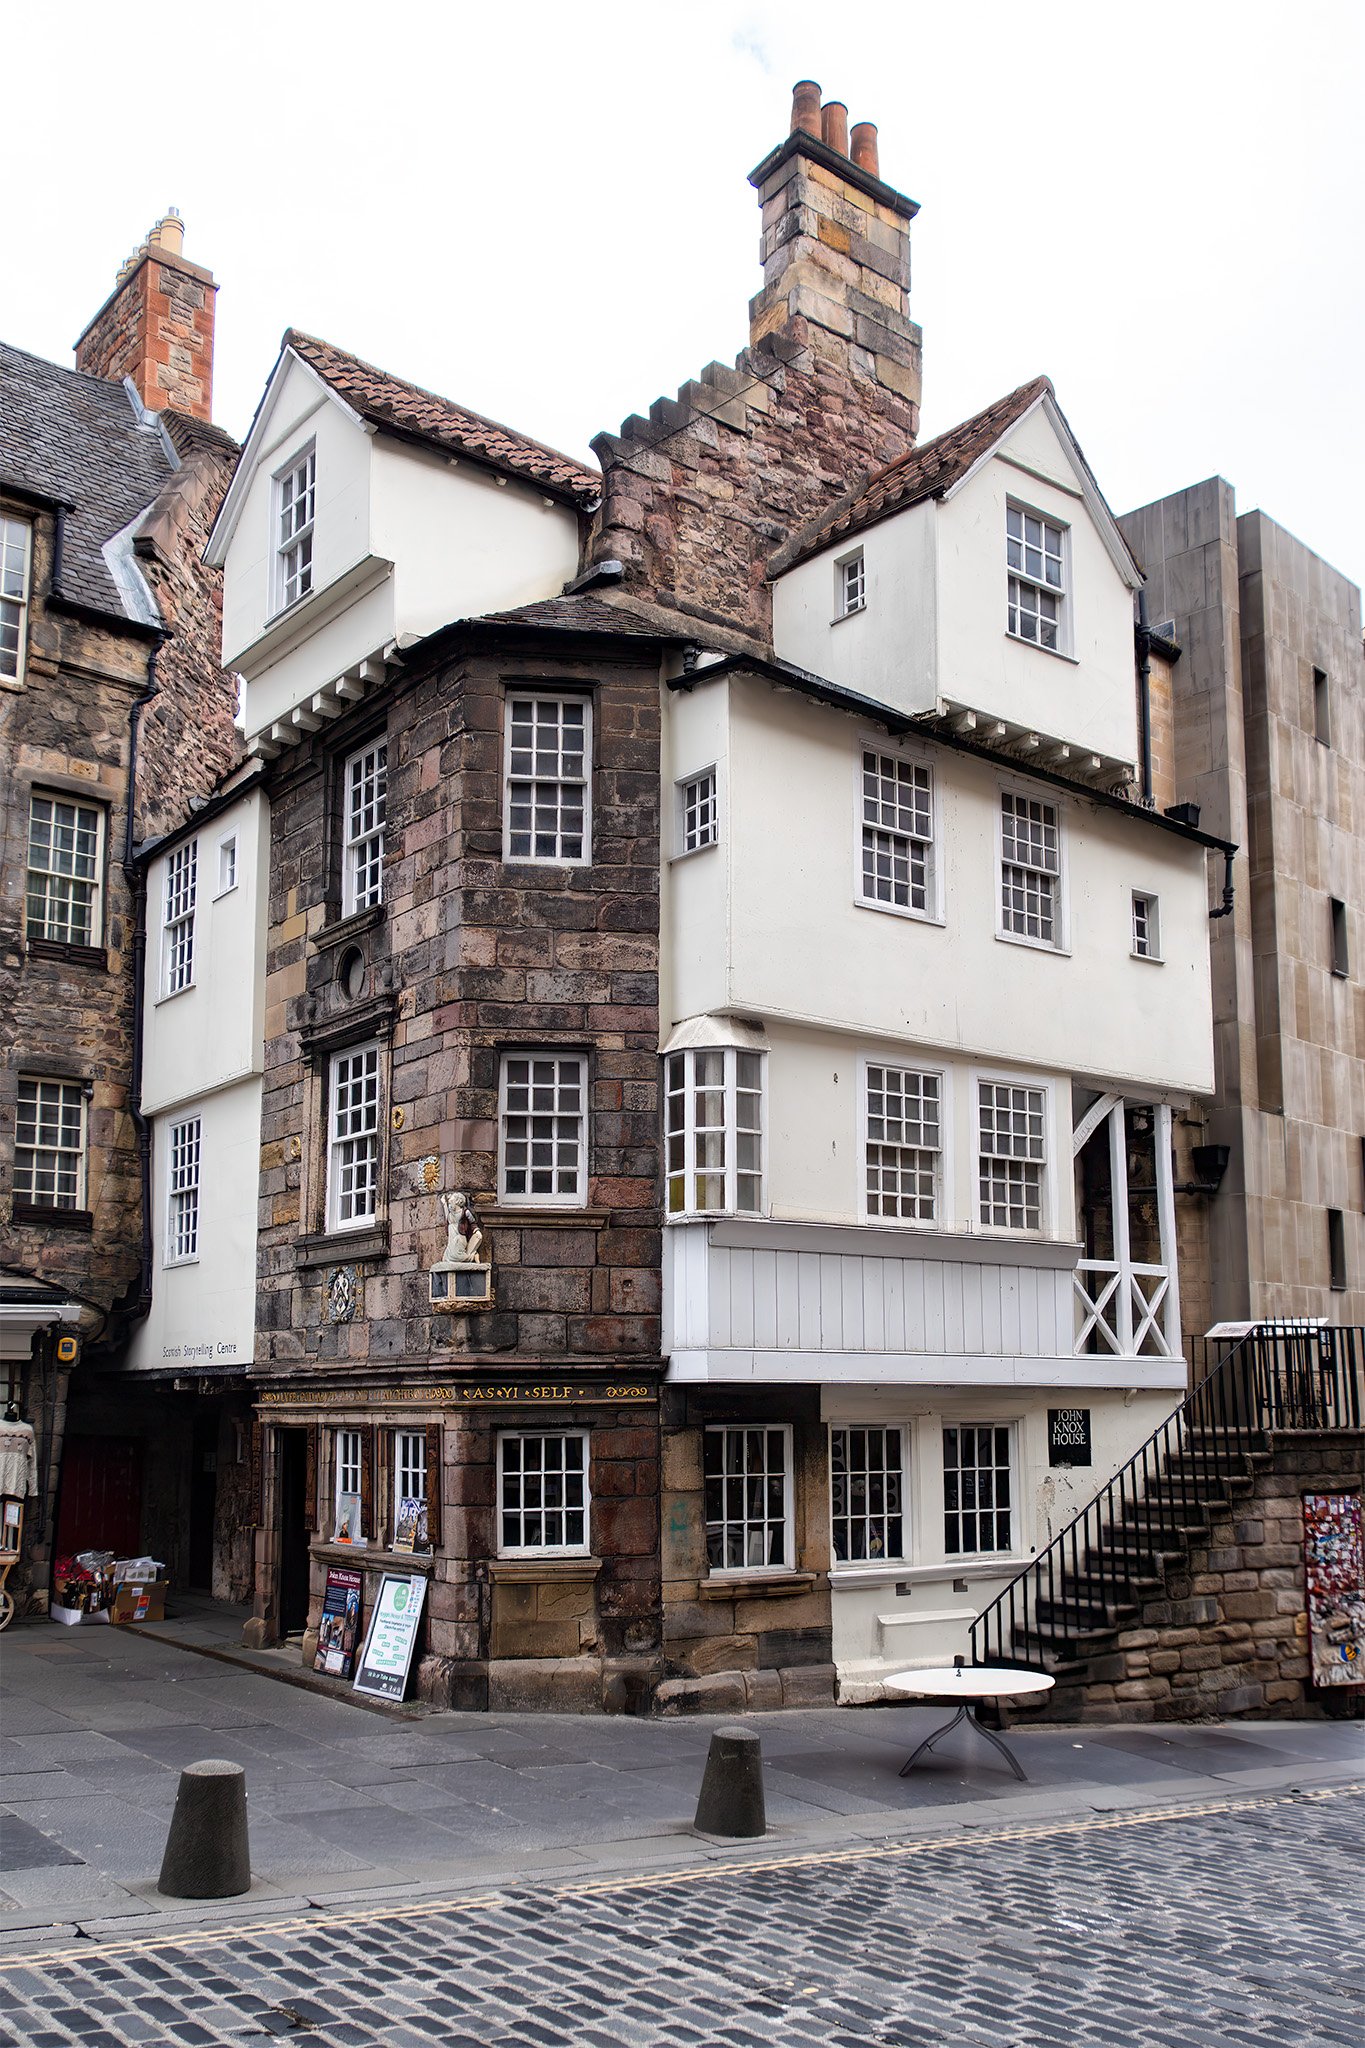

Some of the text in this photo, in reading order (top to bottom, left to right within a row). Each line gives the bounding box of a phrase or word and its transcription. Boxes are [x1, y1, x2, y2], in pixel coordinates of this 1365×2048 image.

[183, 1343, 213, 1360] Storytelling
[217, 1342, 236, 1354] Centre
[472, 1387, 495, 1399] AS
[502, 1386, 519, 1399] YI
[531, 1386, 574, 1398] SELF
[1057, 1410, 1083, 1421] JOHN
[1053, 1421, 1085, 1433] KNOX
[1052, 1433, 1087, 1445] HOUSE
[329, 1570, 339, 1579] John
[339, 1572, 349, 1581] Knox
[349, 1574, 360, 1583] House
